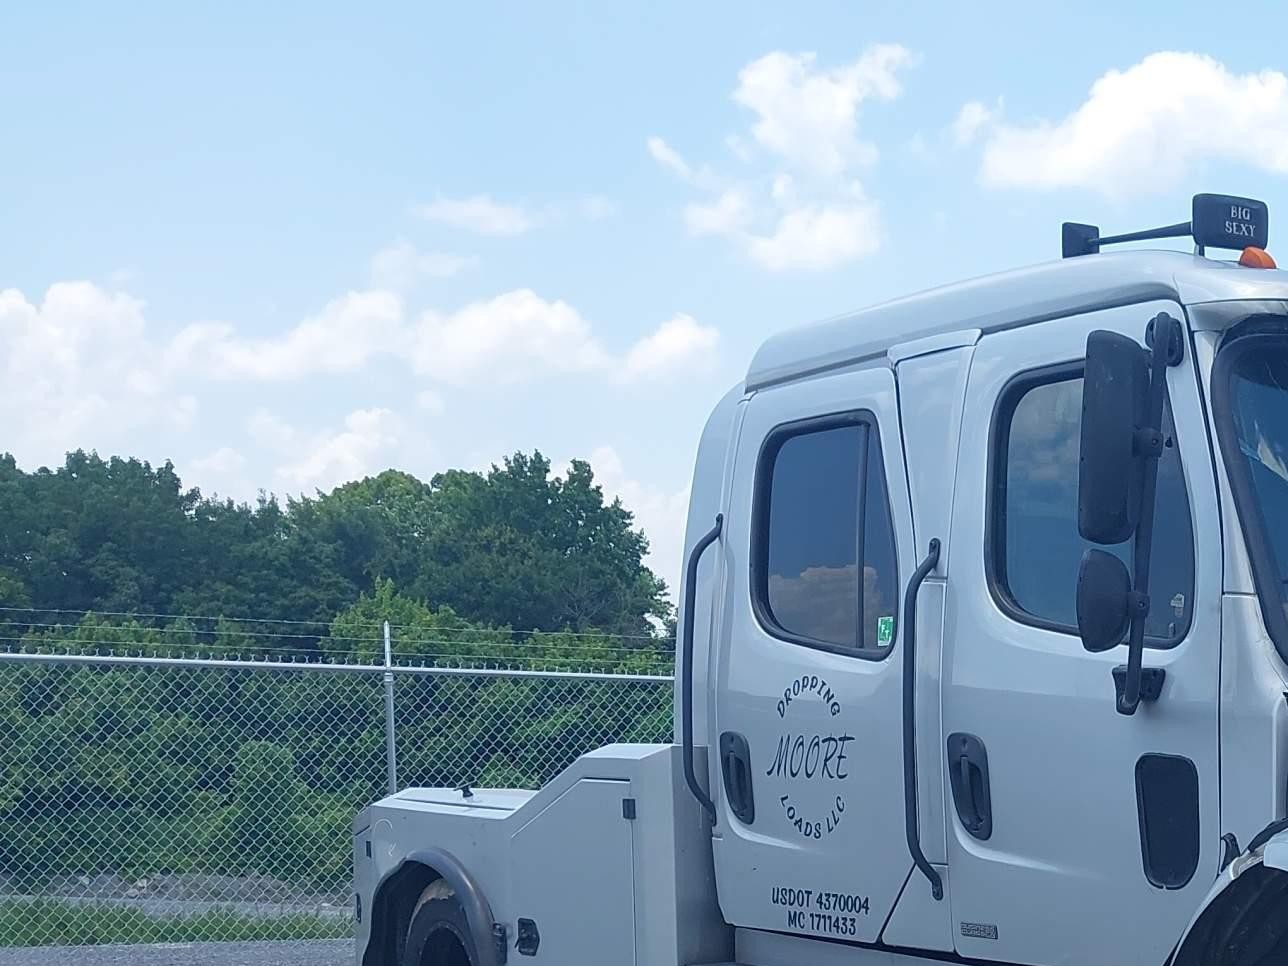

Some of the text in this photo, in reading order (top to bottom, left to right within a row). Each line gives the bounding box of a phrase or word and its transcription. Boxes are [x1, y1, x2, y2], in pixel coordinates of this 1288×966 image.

[1231, 205, 1251, 220] BIG
[1225, 220, 1256, 238] SEXY
[776, 675, 841, 719] DROPPING
[766, 733, 856, 780] MOORE
[780, 794, 845, 840] LOADS LLC
[771, 887, 870, 915] USDOT 4370004
[787, 910, 857, 936] MC 1711433
